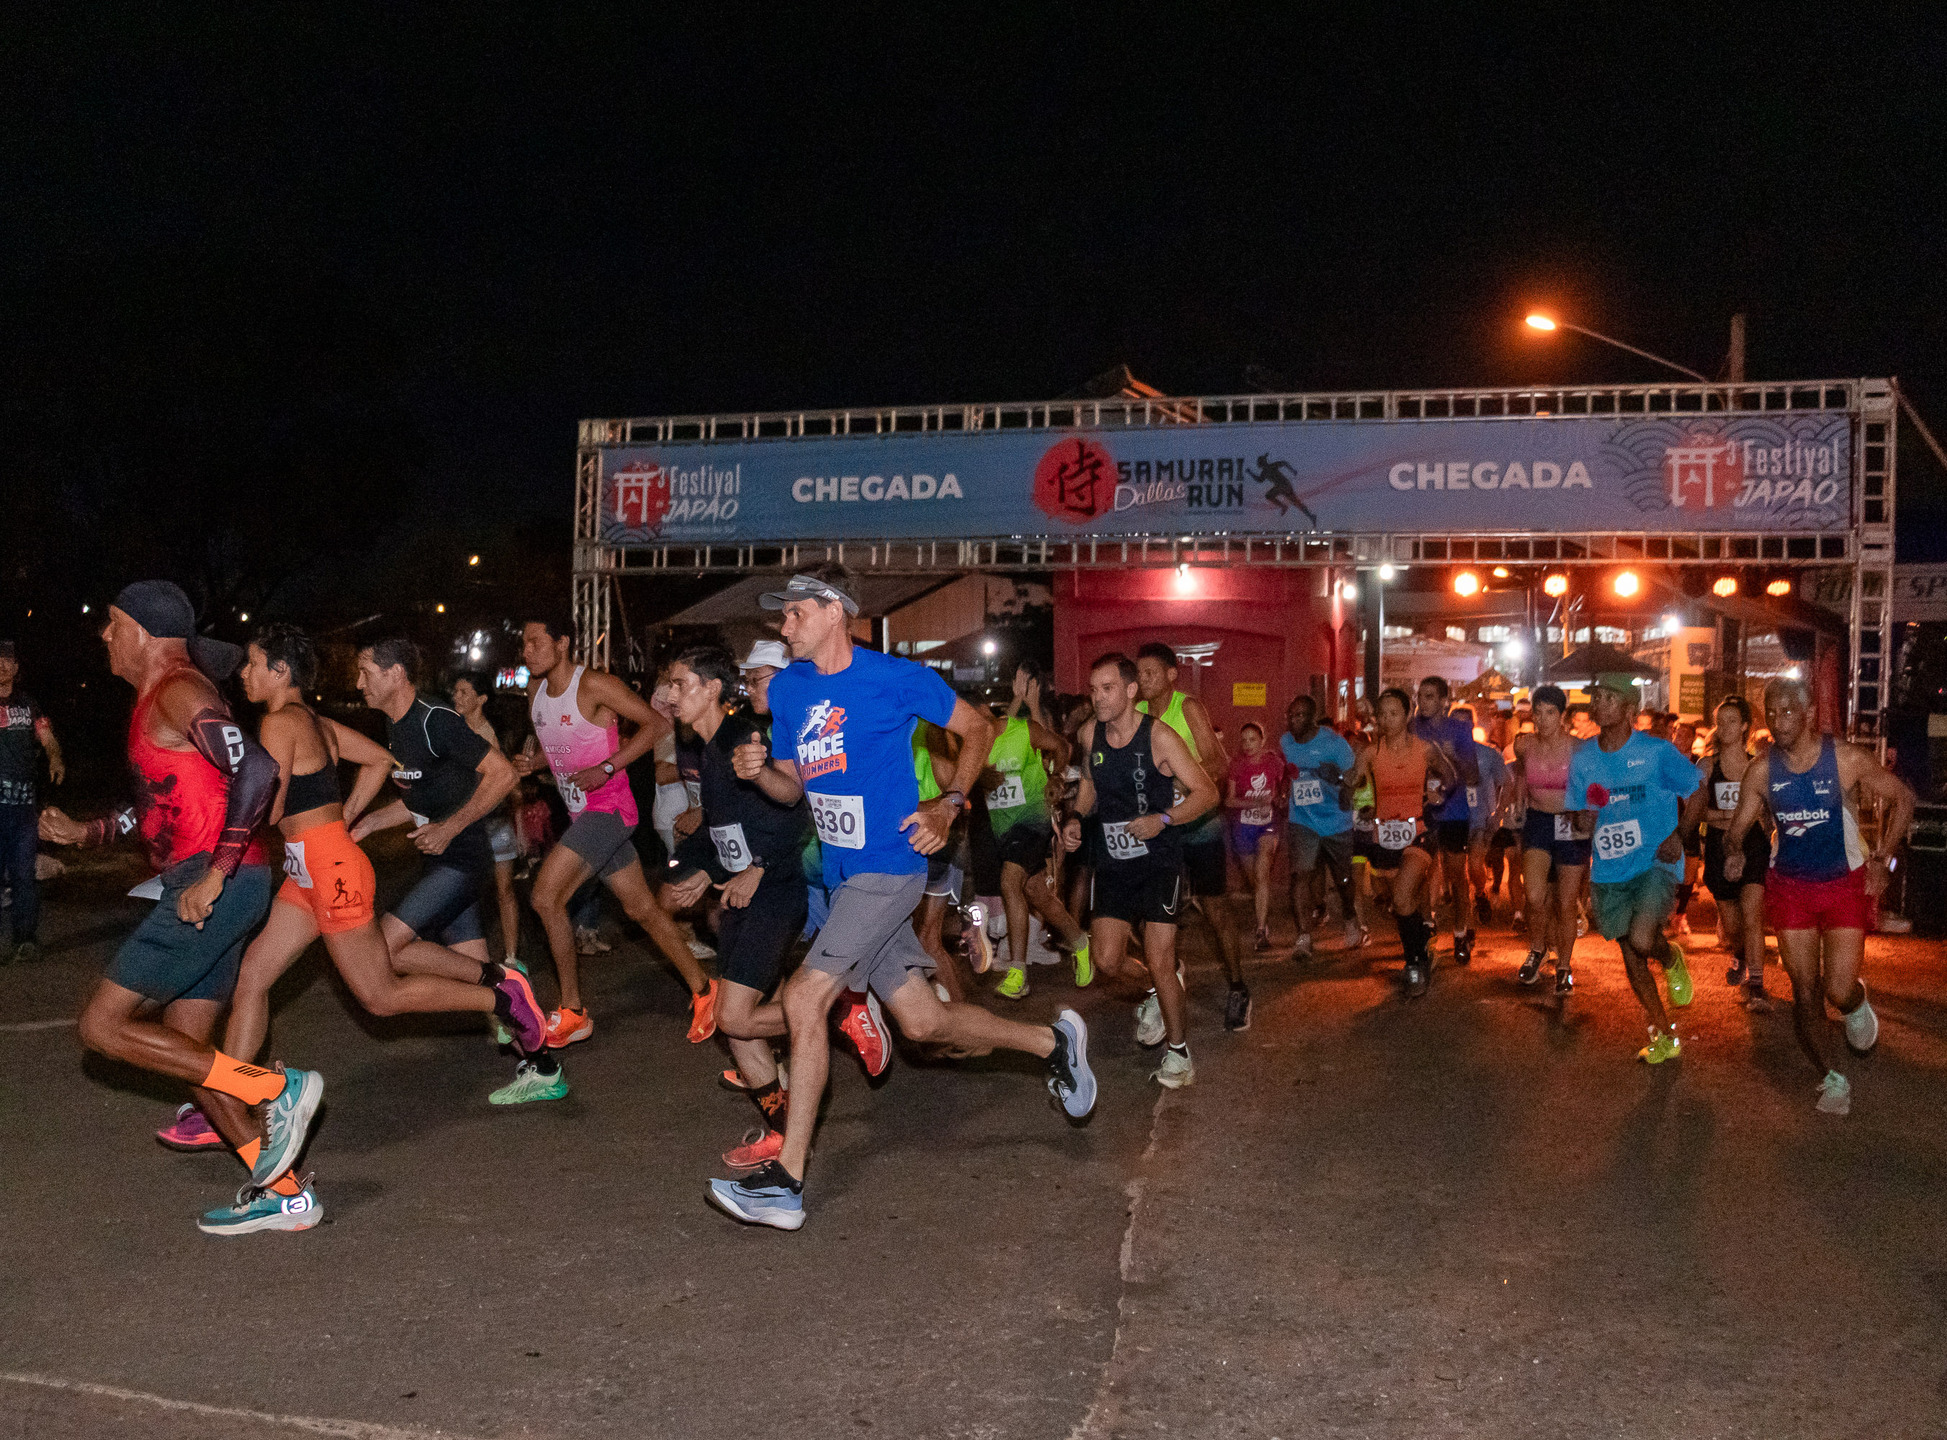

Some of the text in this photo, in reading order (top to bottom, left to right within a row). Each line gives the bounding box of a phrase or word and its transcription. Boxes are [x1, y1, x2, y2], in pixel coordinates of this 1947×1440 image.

[1743, 436, 1840, 476] Festival
[670, 462, 741, 497] Festival
[1055, 440, 1103, 517] 侍
[1117, 459, 1247, 483] SAMURAI
[1389, 461, 1593, 490] CHEGADA
[791, 473, 963, 502] CHEGADA
[1114, 481, 1243, 512] Dallas RUN
[544, 745, 573, 754] AMIGOS
[797, 732, 844, 766] PACE
[990, 785, 1017, 801] 347
[1296, 787, 1321, 800] 246
[813, 807, 856, 835] 330
[1776, 808, 1830, 824] Reebok
[1106, 832, 1145, 850] 301
[1382, 829, 1412, 842] 280
[1599, 831, 1636, 850] 385
